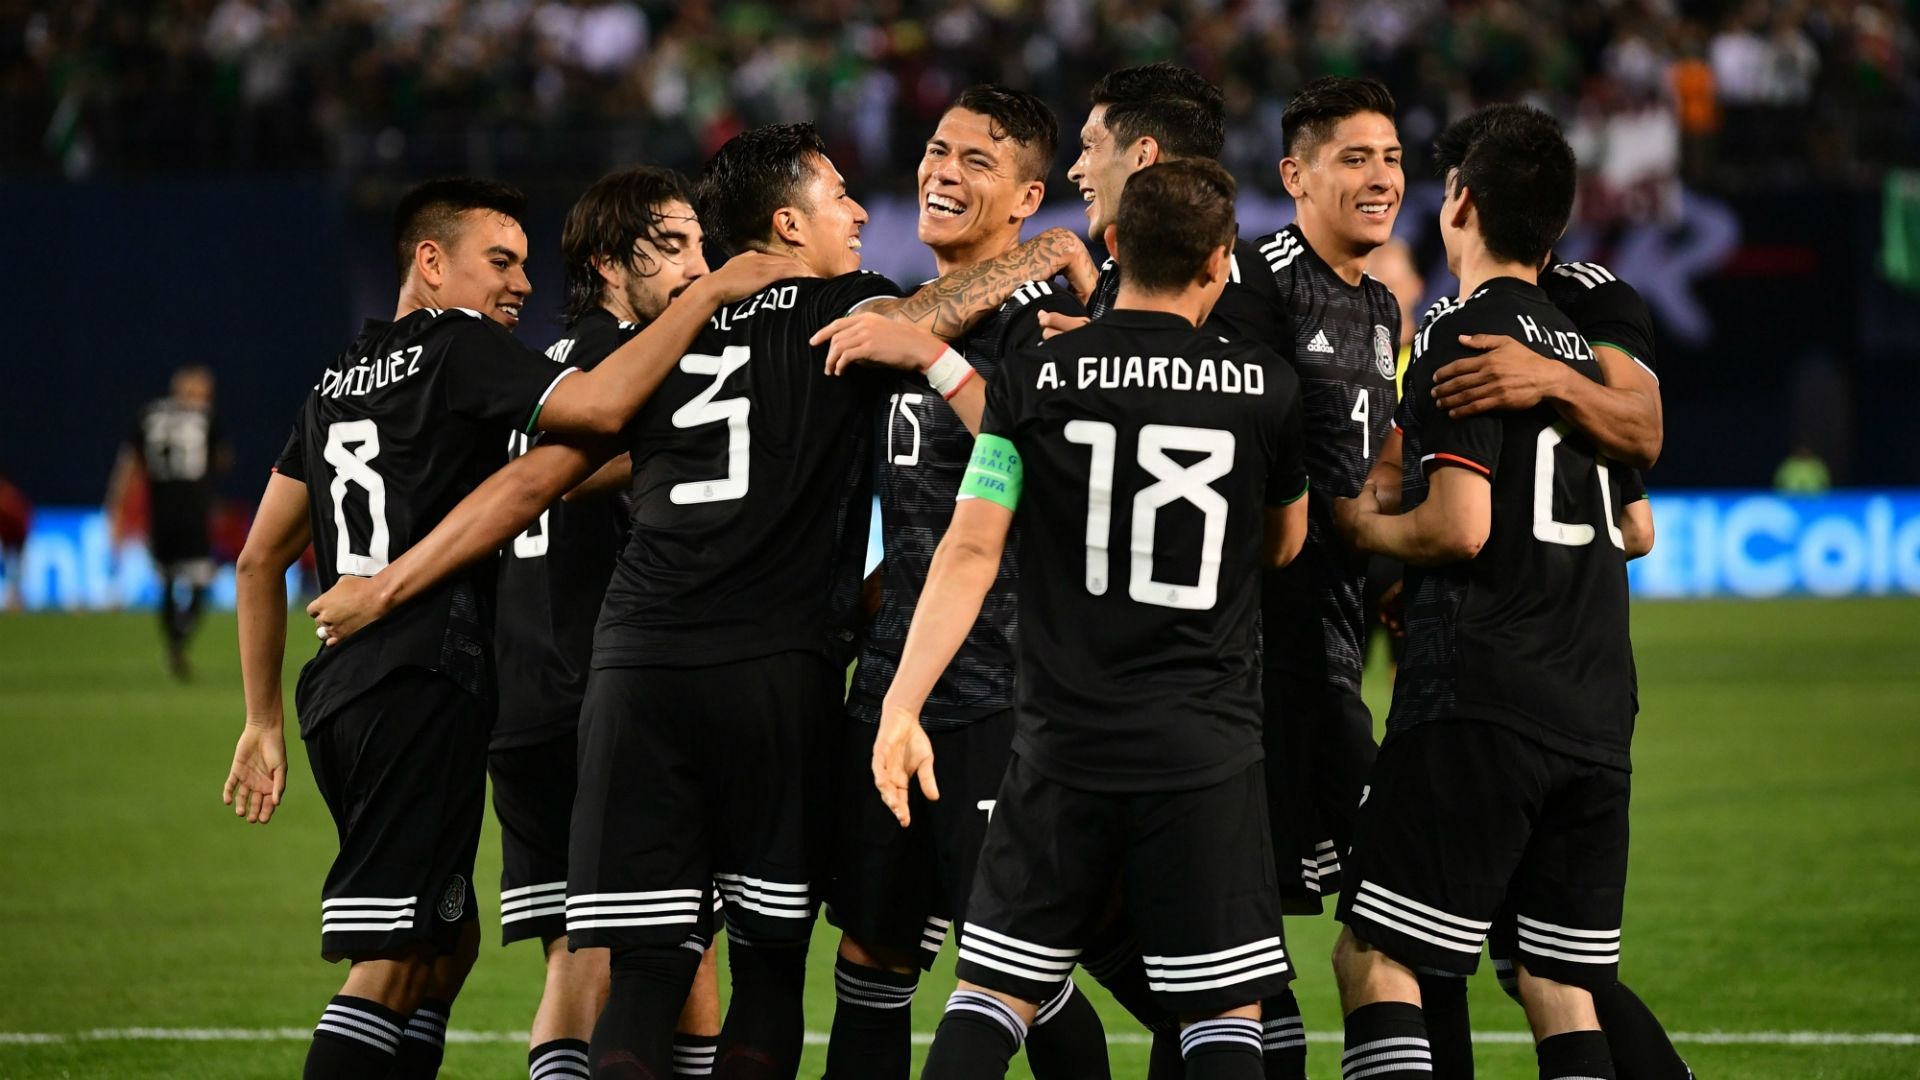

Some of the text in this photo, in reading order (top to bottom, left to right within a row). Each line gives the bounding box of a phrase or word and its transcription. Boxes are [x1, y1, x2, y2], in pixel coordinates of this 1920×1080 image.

[1036, 356, 1265, 395] A. GUARDADO
[1307, 343, 1334, 354] adidas
[669, 345, 751, 505] 3
[887, 392, 924, 466] 15
[1350, 388, 1370, 460] 4
[323, 418, 390, 576] 8
[977, 476, 1006, 493] FIFA
[1063, 419, 1236, 610] 18
